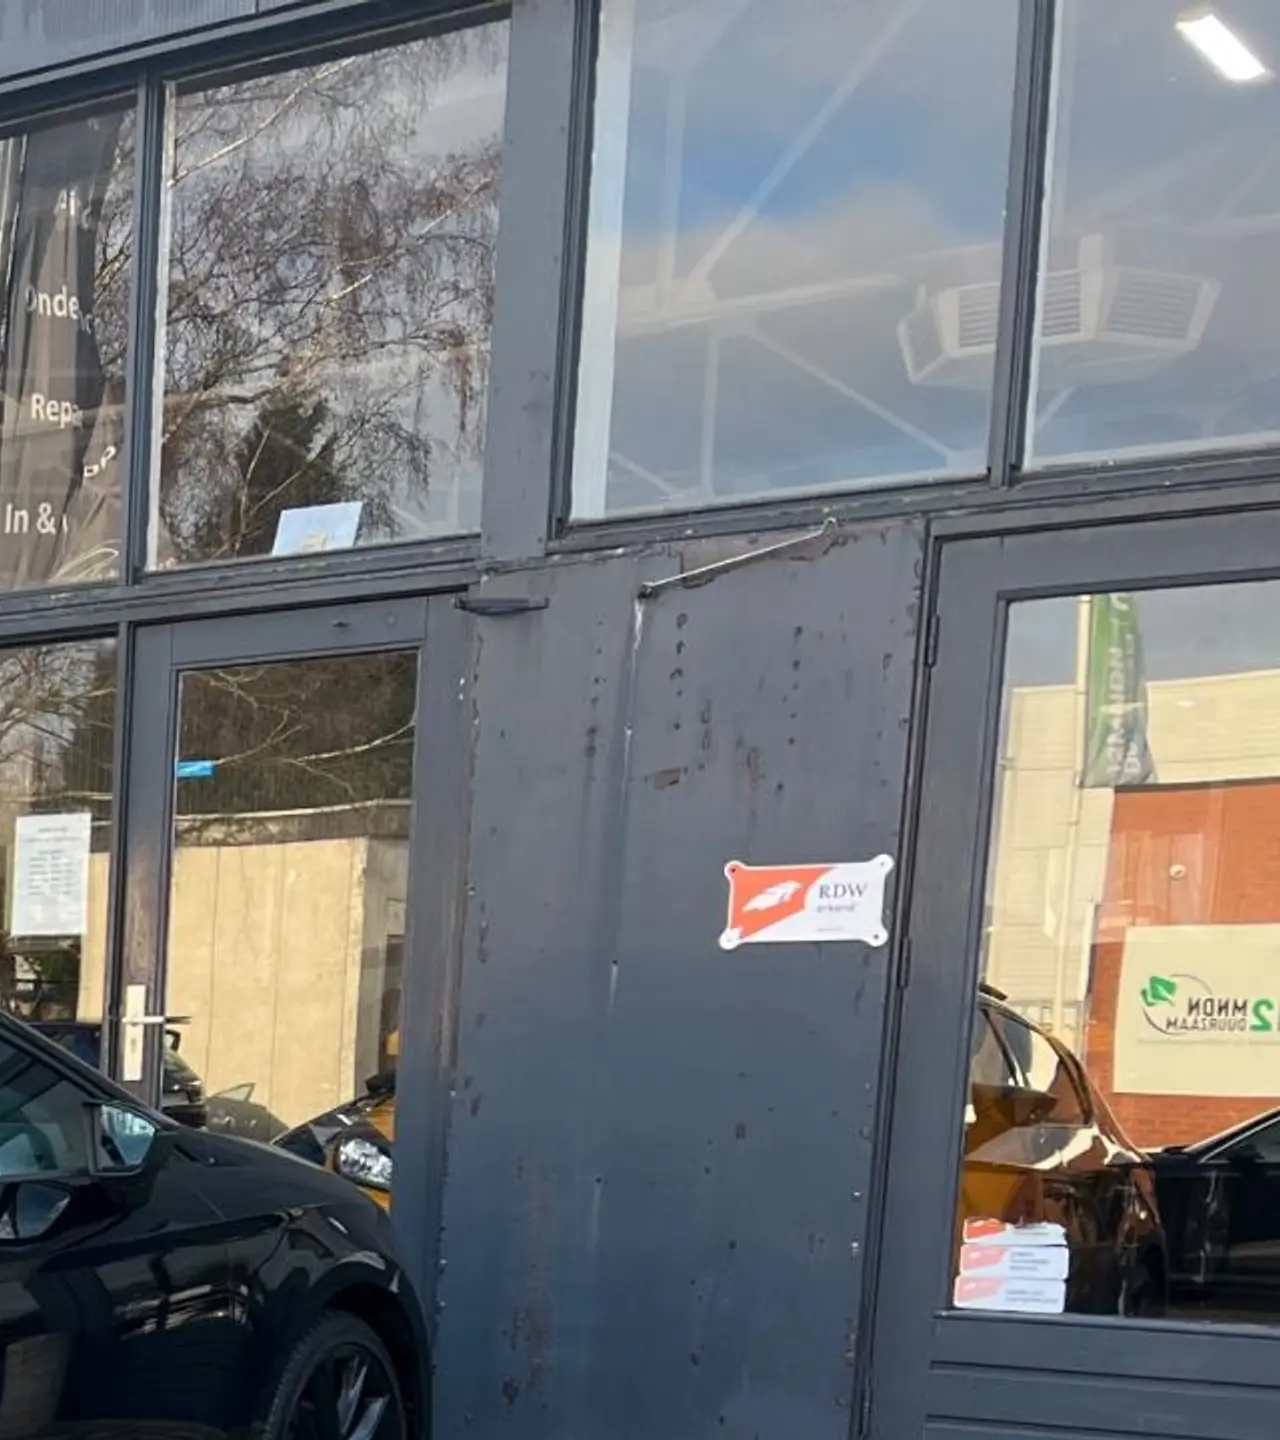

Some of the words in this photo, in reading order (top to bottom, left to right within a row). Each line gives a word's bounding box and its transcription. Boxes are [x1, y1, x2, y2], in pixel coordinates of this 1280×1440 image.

[4, 503, 30, 534] In
[36, 502, 57, 535] &
[818, 883, 869, 899] RDW
